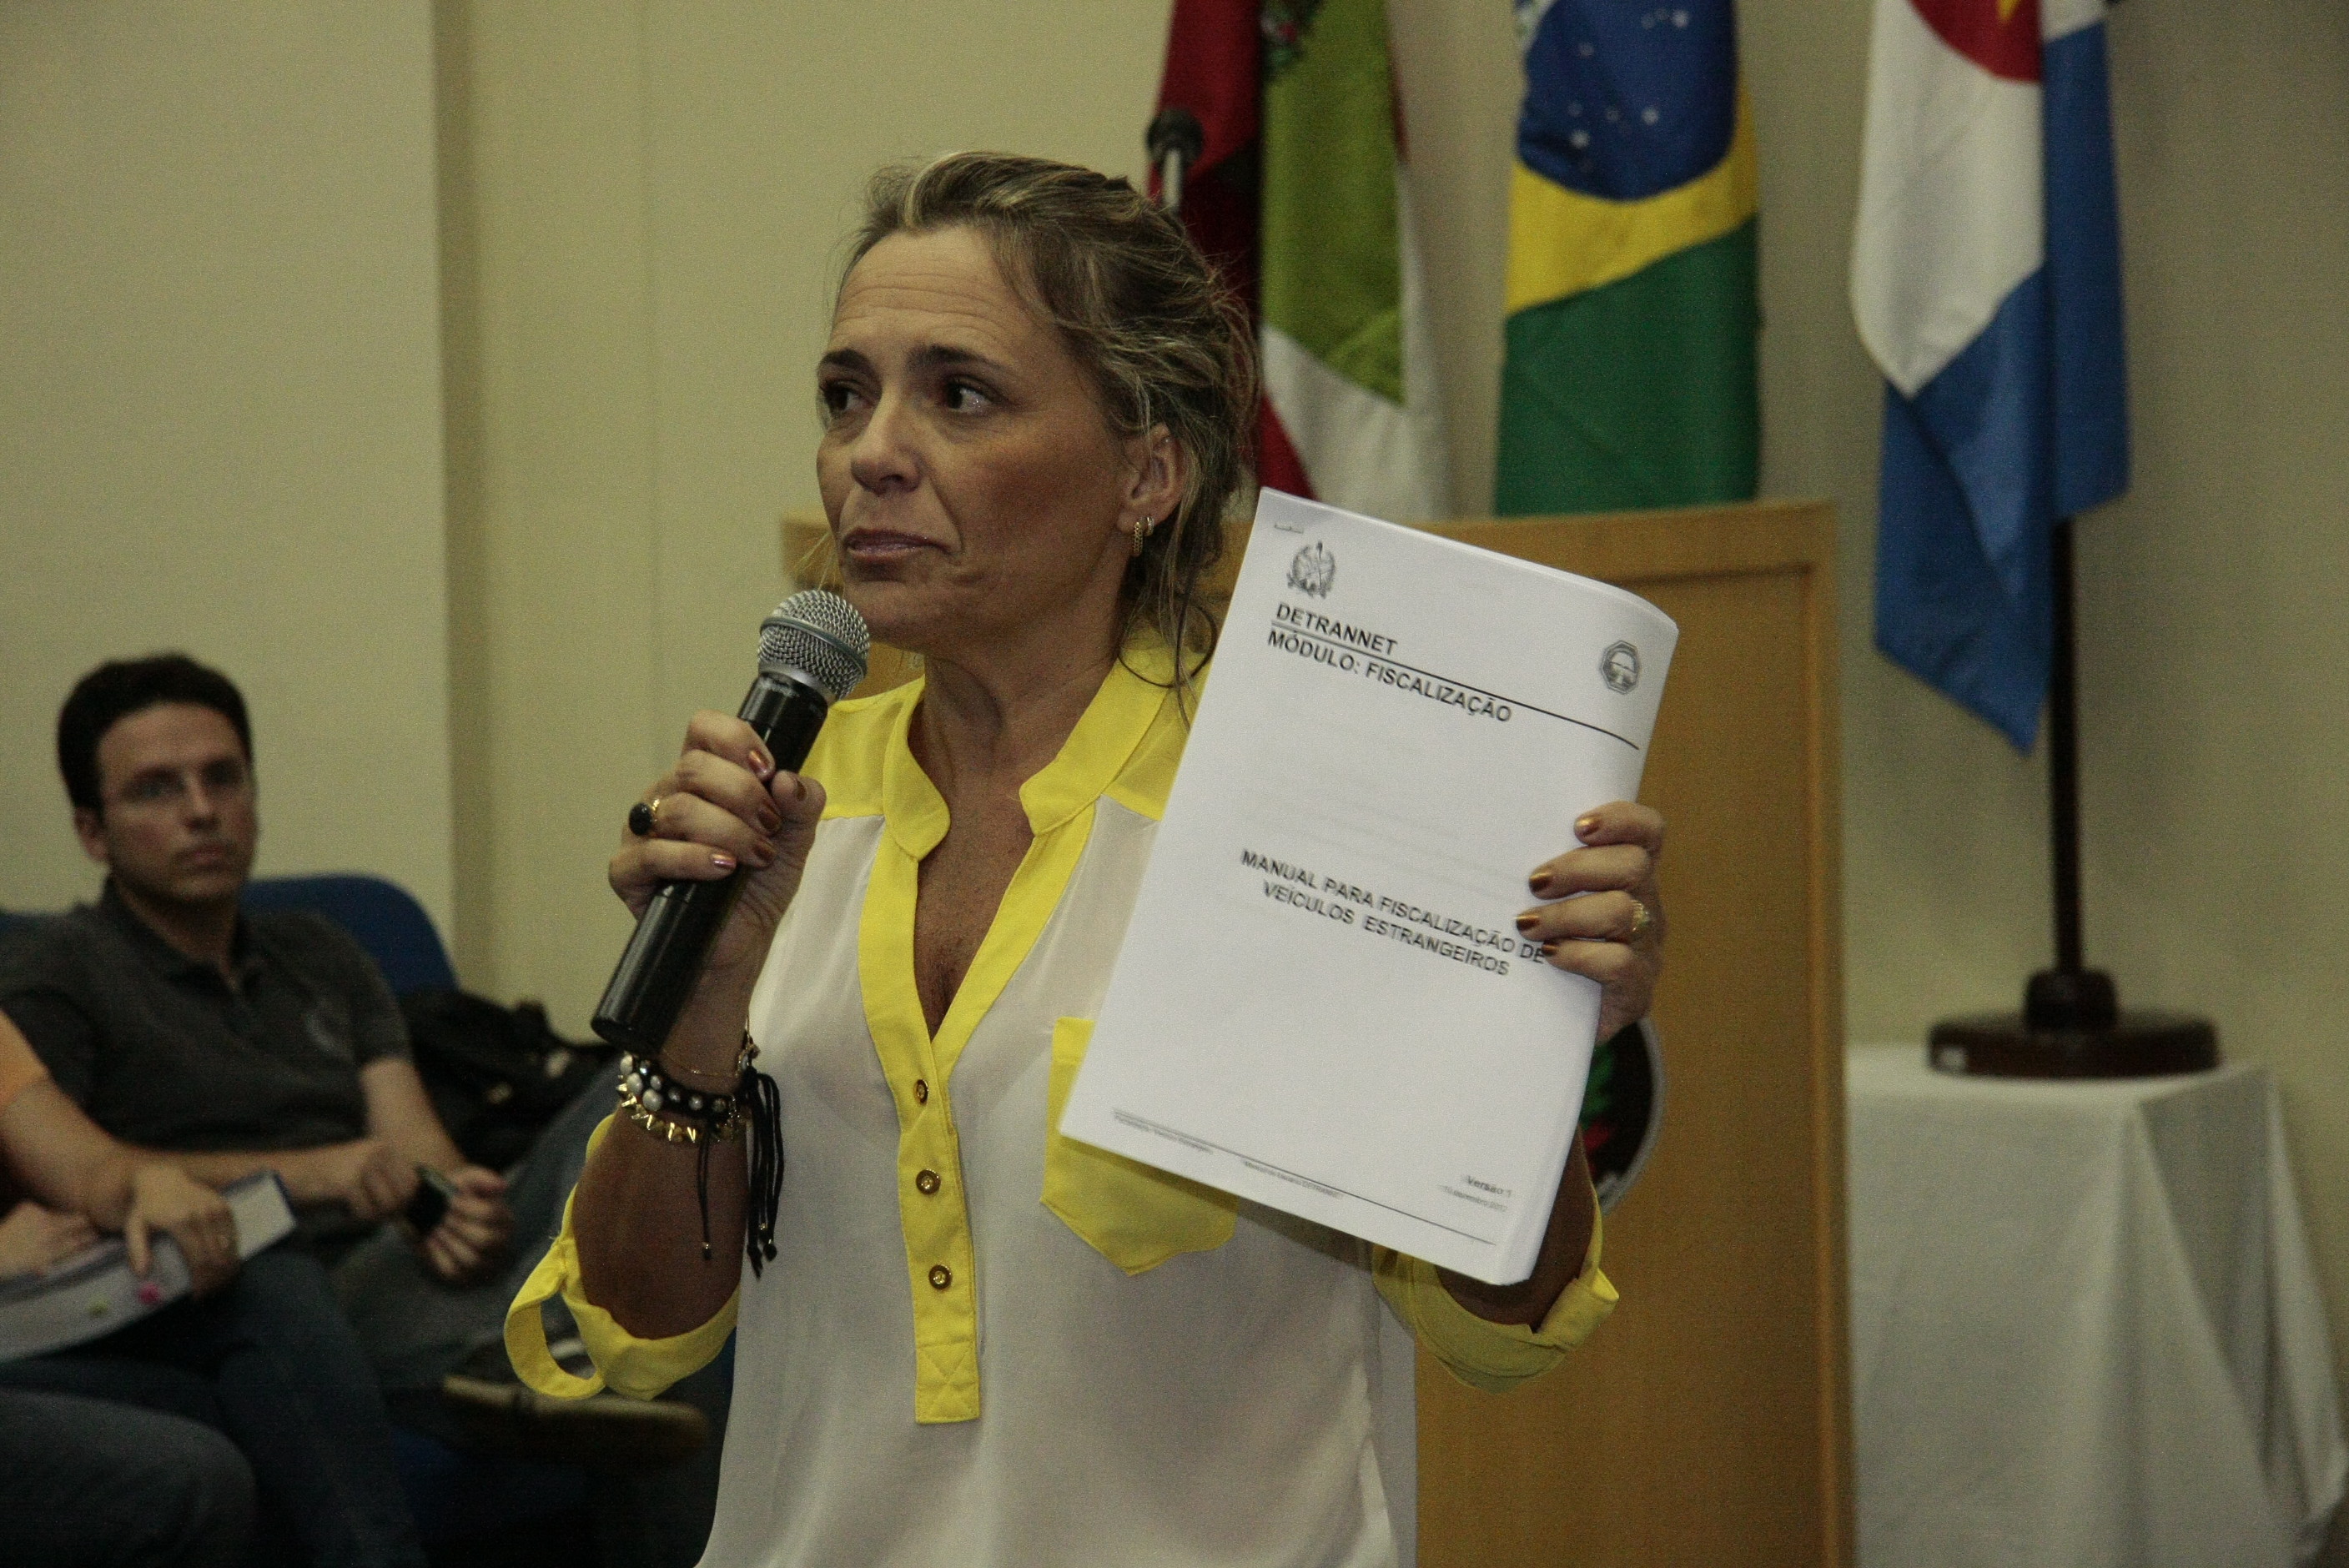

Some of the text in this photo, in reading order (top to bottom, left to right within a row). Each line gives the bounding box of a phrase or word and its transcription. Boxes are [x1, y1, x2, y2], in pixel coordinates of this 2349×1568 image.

[1267, 629, 1512, 722] MÓDULO: FISCALIZAÇÃO
[1275, 602, 1398, 656] DETRANNET
[1241, 849, 1545, 964] MANUAL PARA FISCALIZAÇÃO DE
[1263, 879, 1510, 976] VEÍCULOS ESTRANGEIROS
